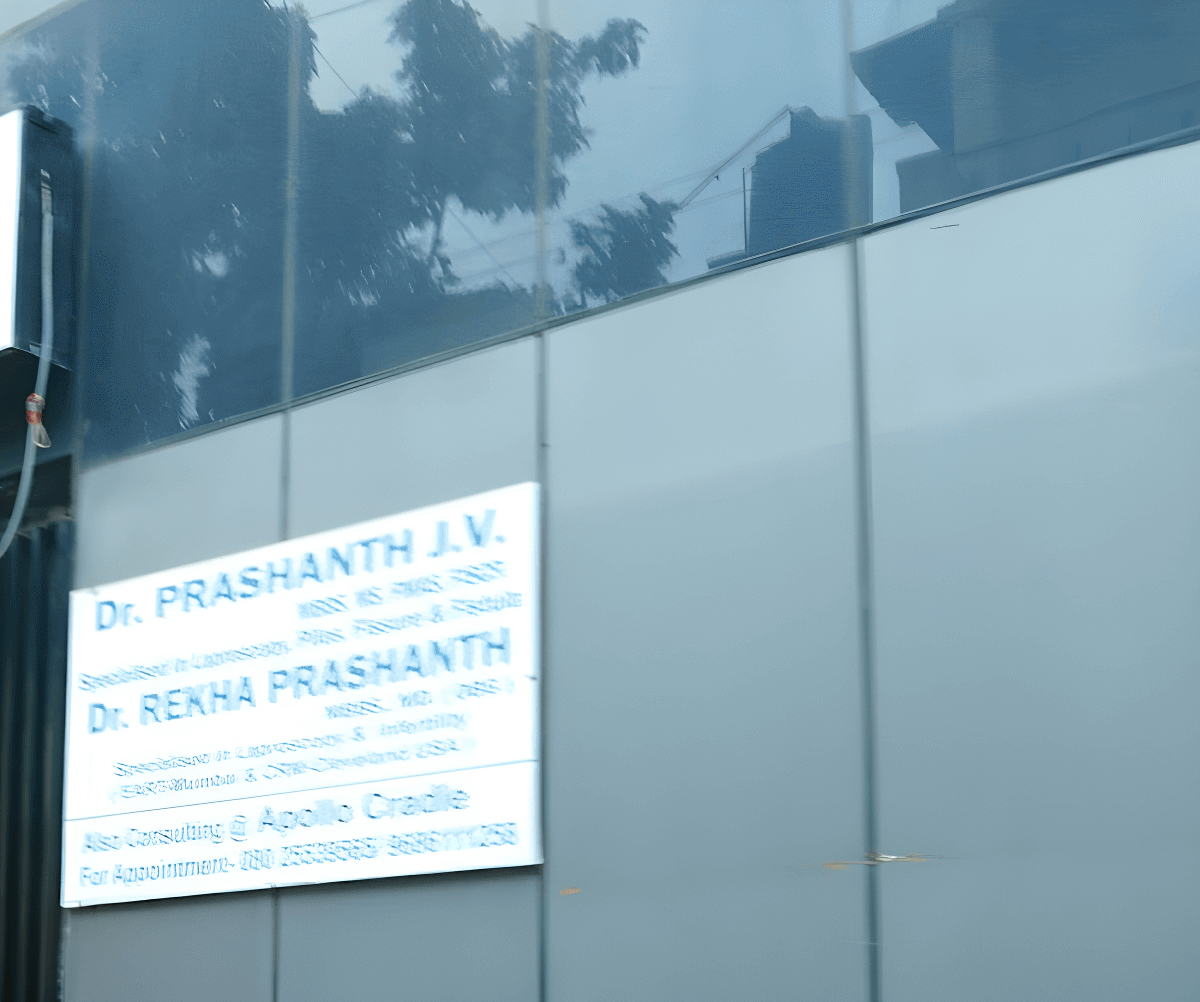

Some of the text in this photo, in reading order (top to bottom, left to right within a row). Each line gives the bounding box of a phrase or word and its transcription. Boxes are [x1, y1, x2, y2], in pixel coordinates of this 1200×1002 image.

[94, 599, 143, 632] Dr.
[155, 530, 413, 617] PRASHANTH
[426, 508, 505, 558] J.V.
[87, 627, 509, 734] Dr. REKHA PRASHANTH
[124, 821, 225, 848] Consulting
[256, 798, 353, 837] Apollo
[361, 783, 469, 820] Cradle
[78, 865, 109, 887] For
